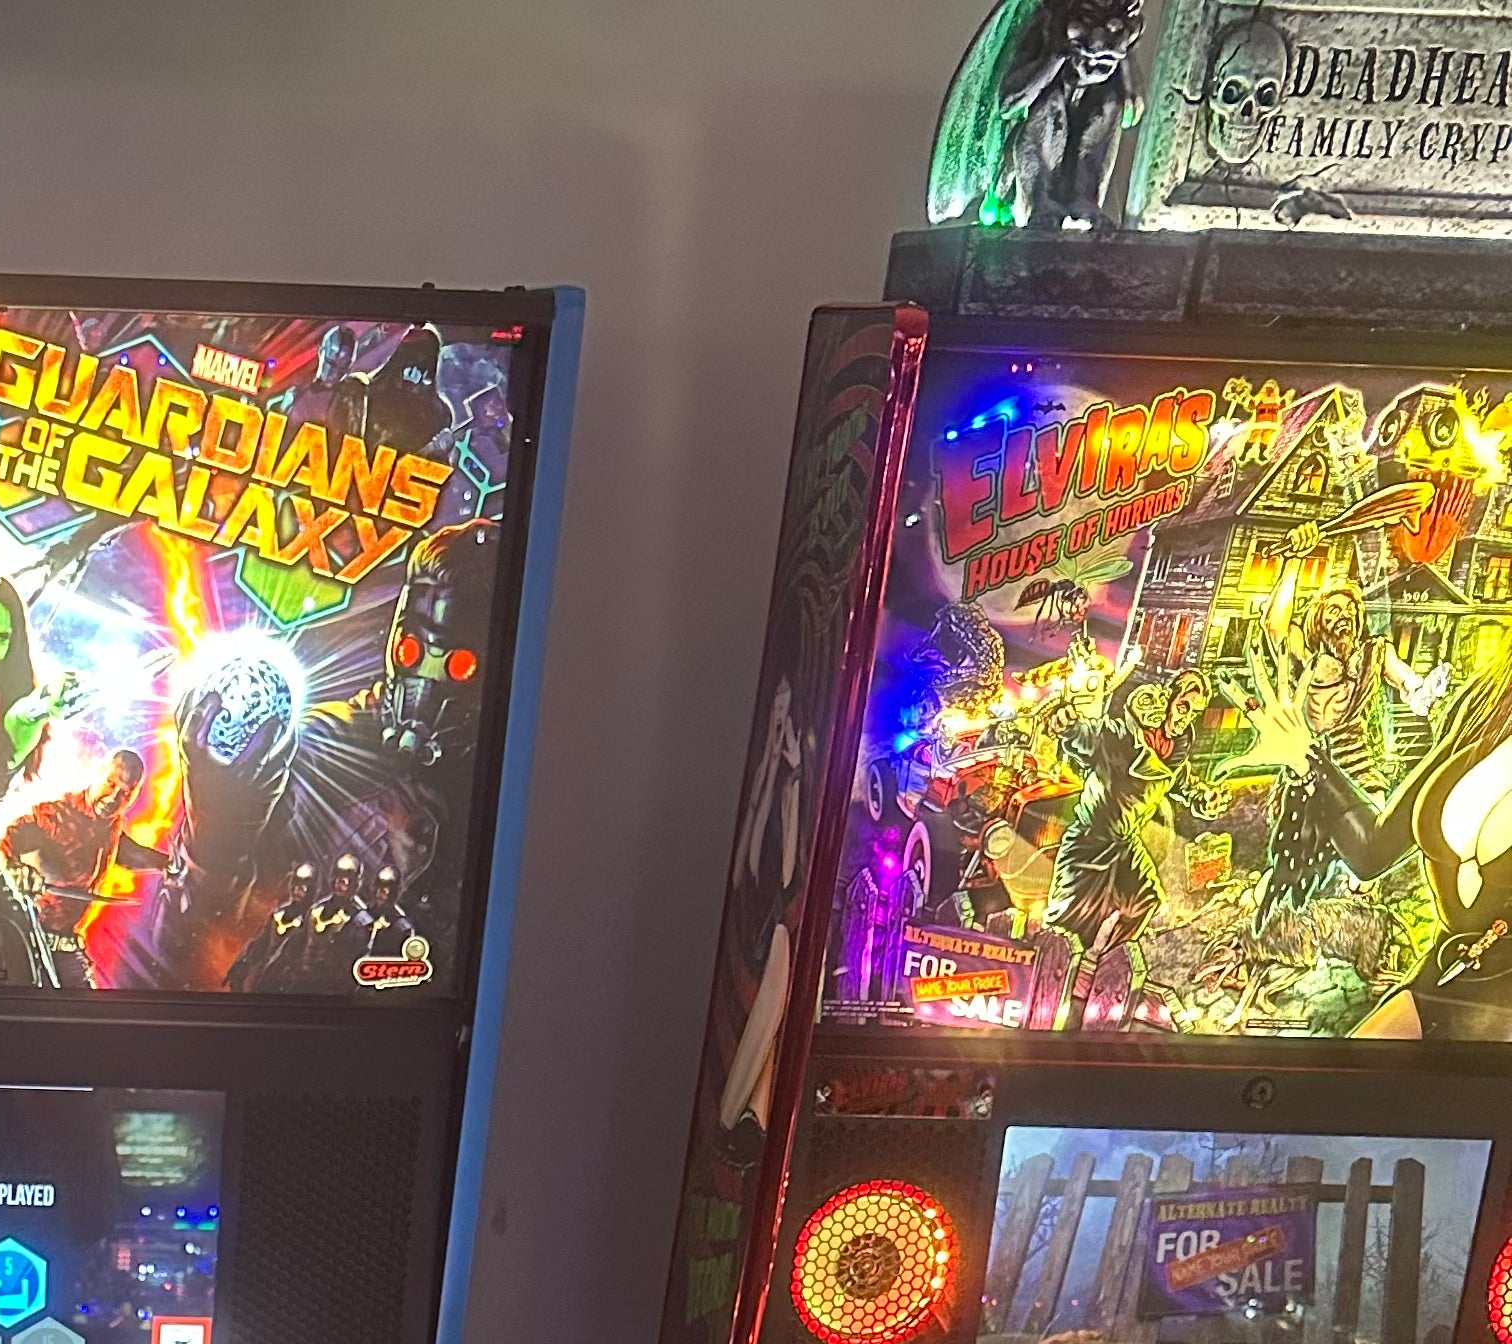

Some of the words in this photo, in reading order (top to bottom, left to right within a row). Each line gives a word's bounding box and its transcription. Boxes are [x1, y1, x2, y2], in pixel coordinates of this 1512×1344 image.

[1265, 115, 1405, 158] FAMILY
[192, 343, 264, 394] MARVEL
[22, 419, 73, 456] OF
[931, 386, 1216, 563] ELVIRA'S
[61, 431, 415, 585] GALAXY
[962, 524, 1065, 602] HOUSE
[1065, 509, 1103, 557] OF
[1101, 476, 1190, 546] HORRORS
[363, 963, 422, 979] Stern
[904, 950, 957, 979] FOR
[916, 981, 943, 996] NAME
[945, 979, 971, 993] YOUR
[974, 975, 1003, 992] PRICE
[949, 994, 1024, 1028] SALE
[1158, 1200, 1247, 1222] ALTERNATE
[1156, 1229, 1220, 1263] FOR
[4, 1257, 14, 1276] 5
[1215, 1258, 1304, 1297] SALE
